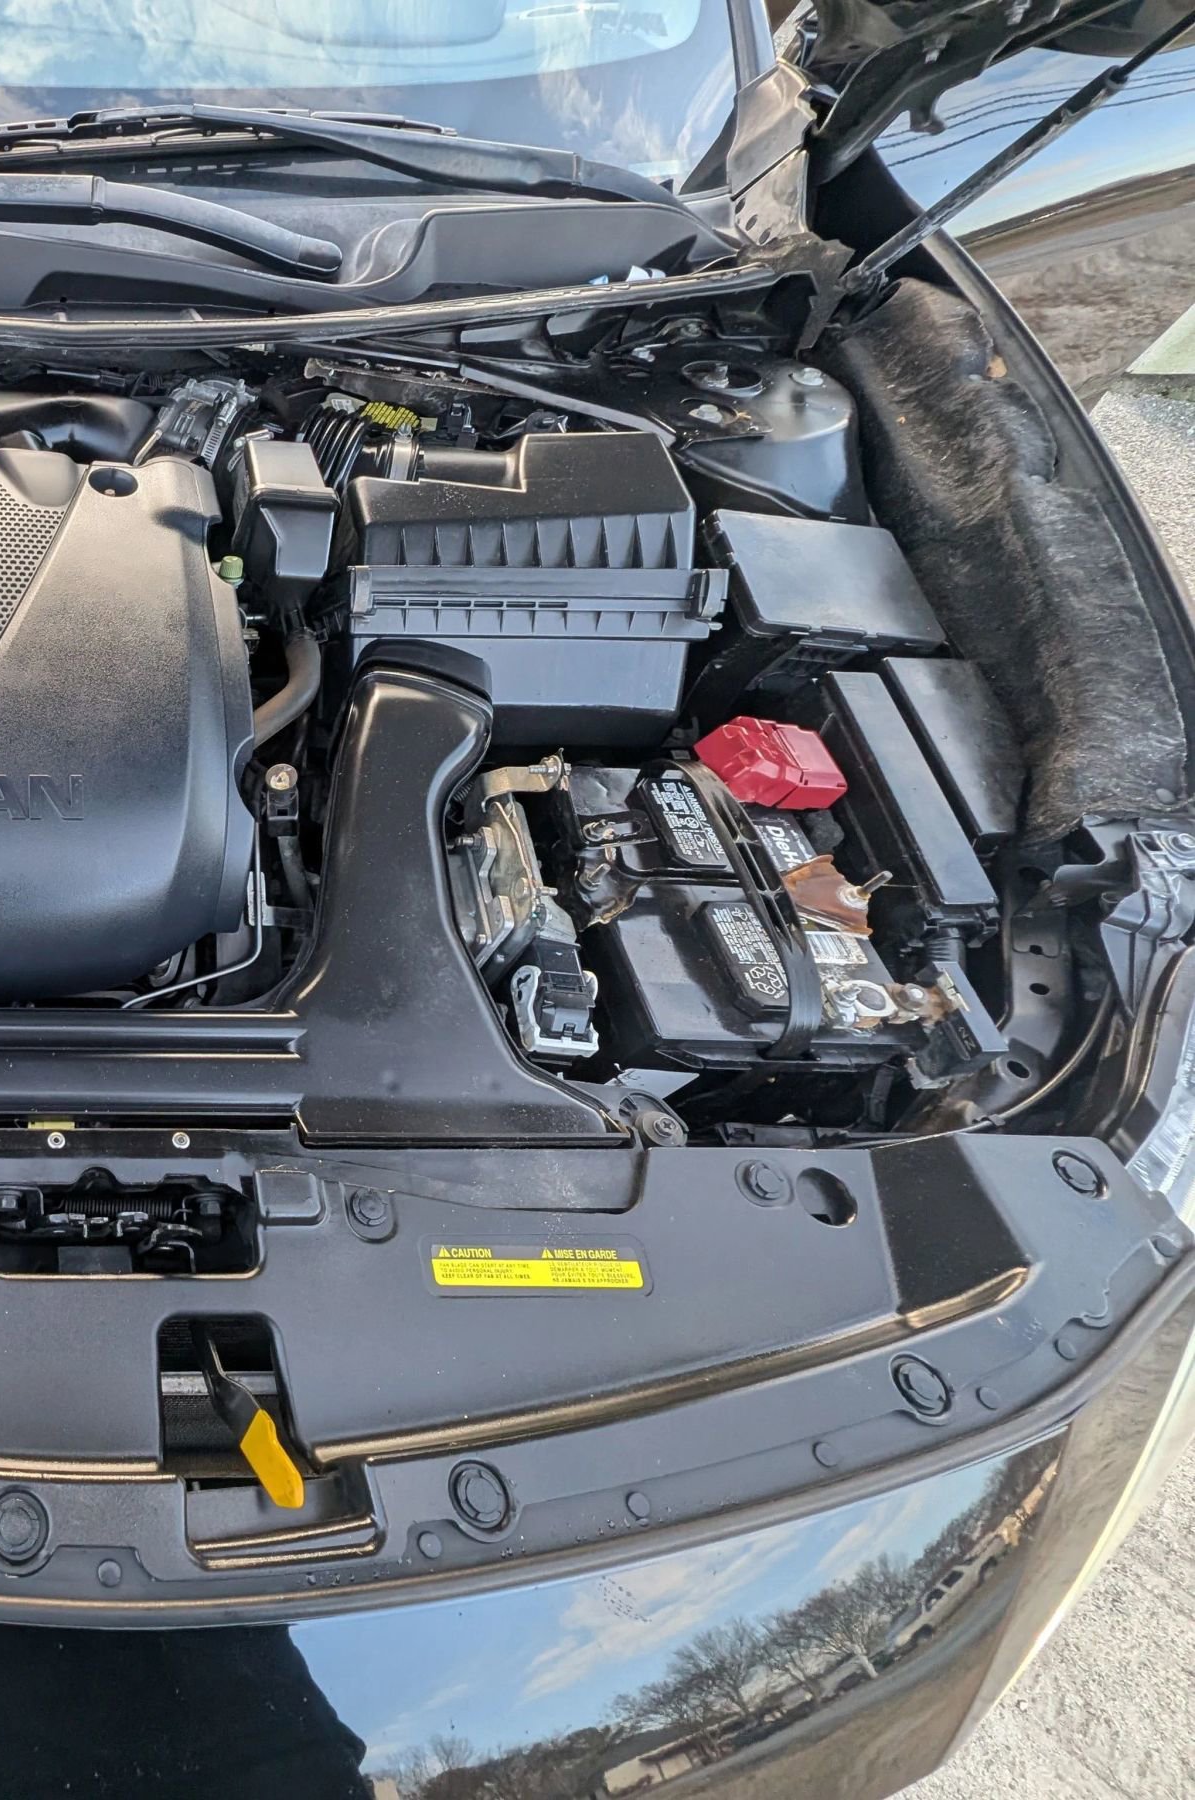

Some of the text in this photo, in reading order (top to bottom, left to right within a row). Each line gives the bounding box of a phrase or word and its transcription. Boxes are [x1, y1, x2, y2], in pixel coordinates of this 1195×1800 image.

[687, 792, 707, 821] DANGER
[704, 827, 725, 855] POISON
[765, 825, 803, 869] DieH
[450, 1247, 492, 1258] CAUTION
[553, 1248, 618, 1260] MISE EN GARDE
